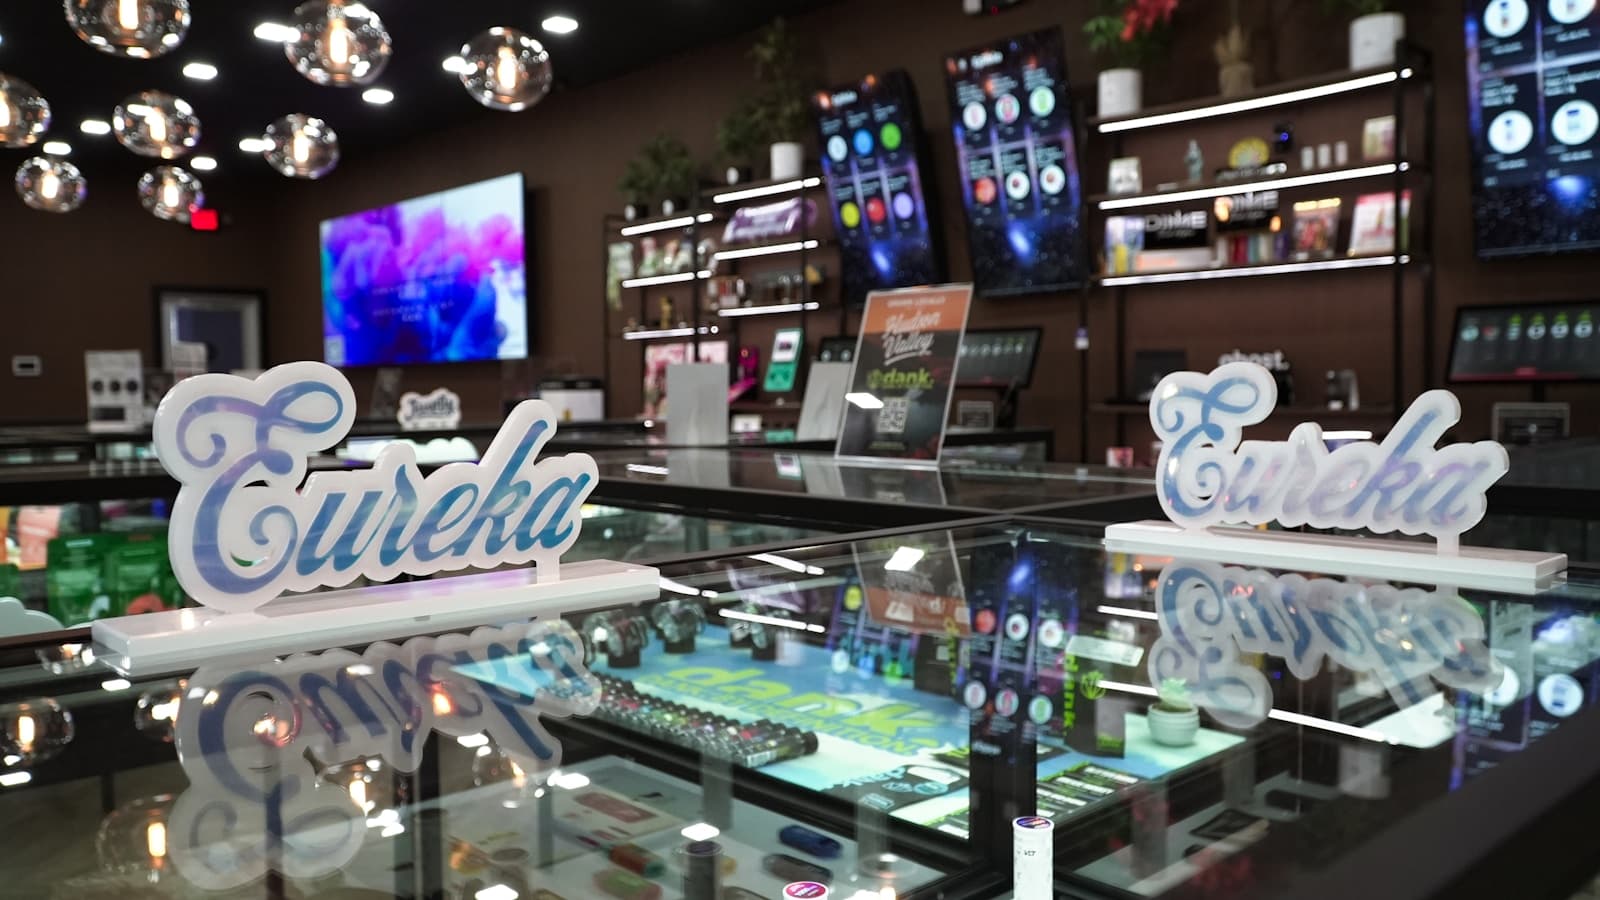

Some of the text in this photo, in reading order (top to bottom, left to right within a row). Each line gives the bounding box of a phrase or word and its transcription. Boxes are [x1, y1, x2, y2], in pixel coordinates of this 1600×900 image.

[882, 310, 941, 339] Hudson
[883, 333, 935, 360] Valley
[176, 380, 591, 594] Eureka
[1156, 377, 1490, 525] Eureka
